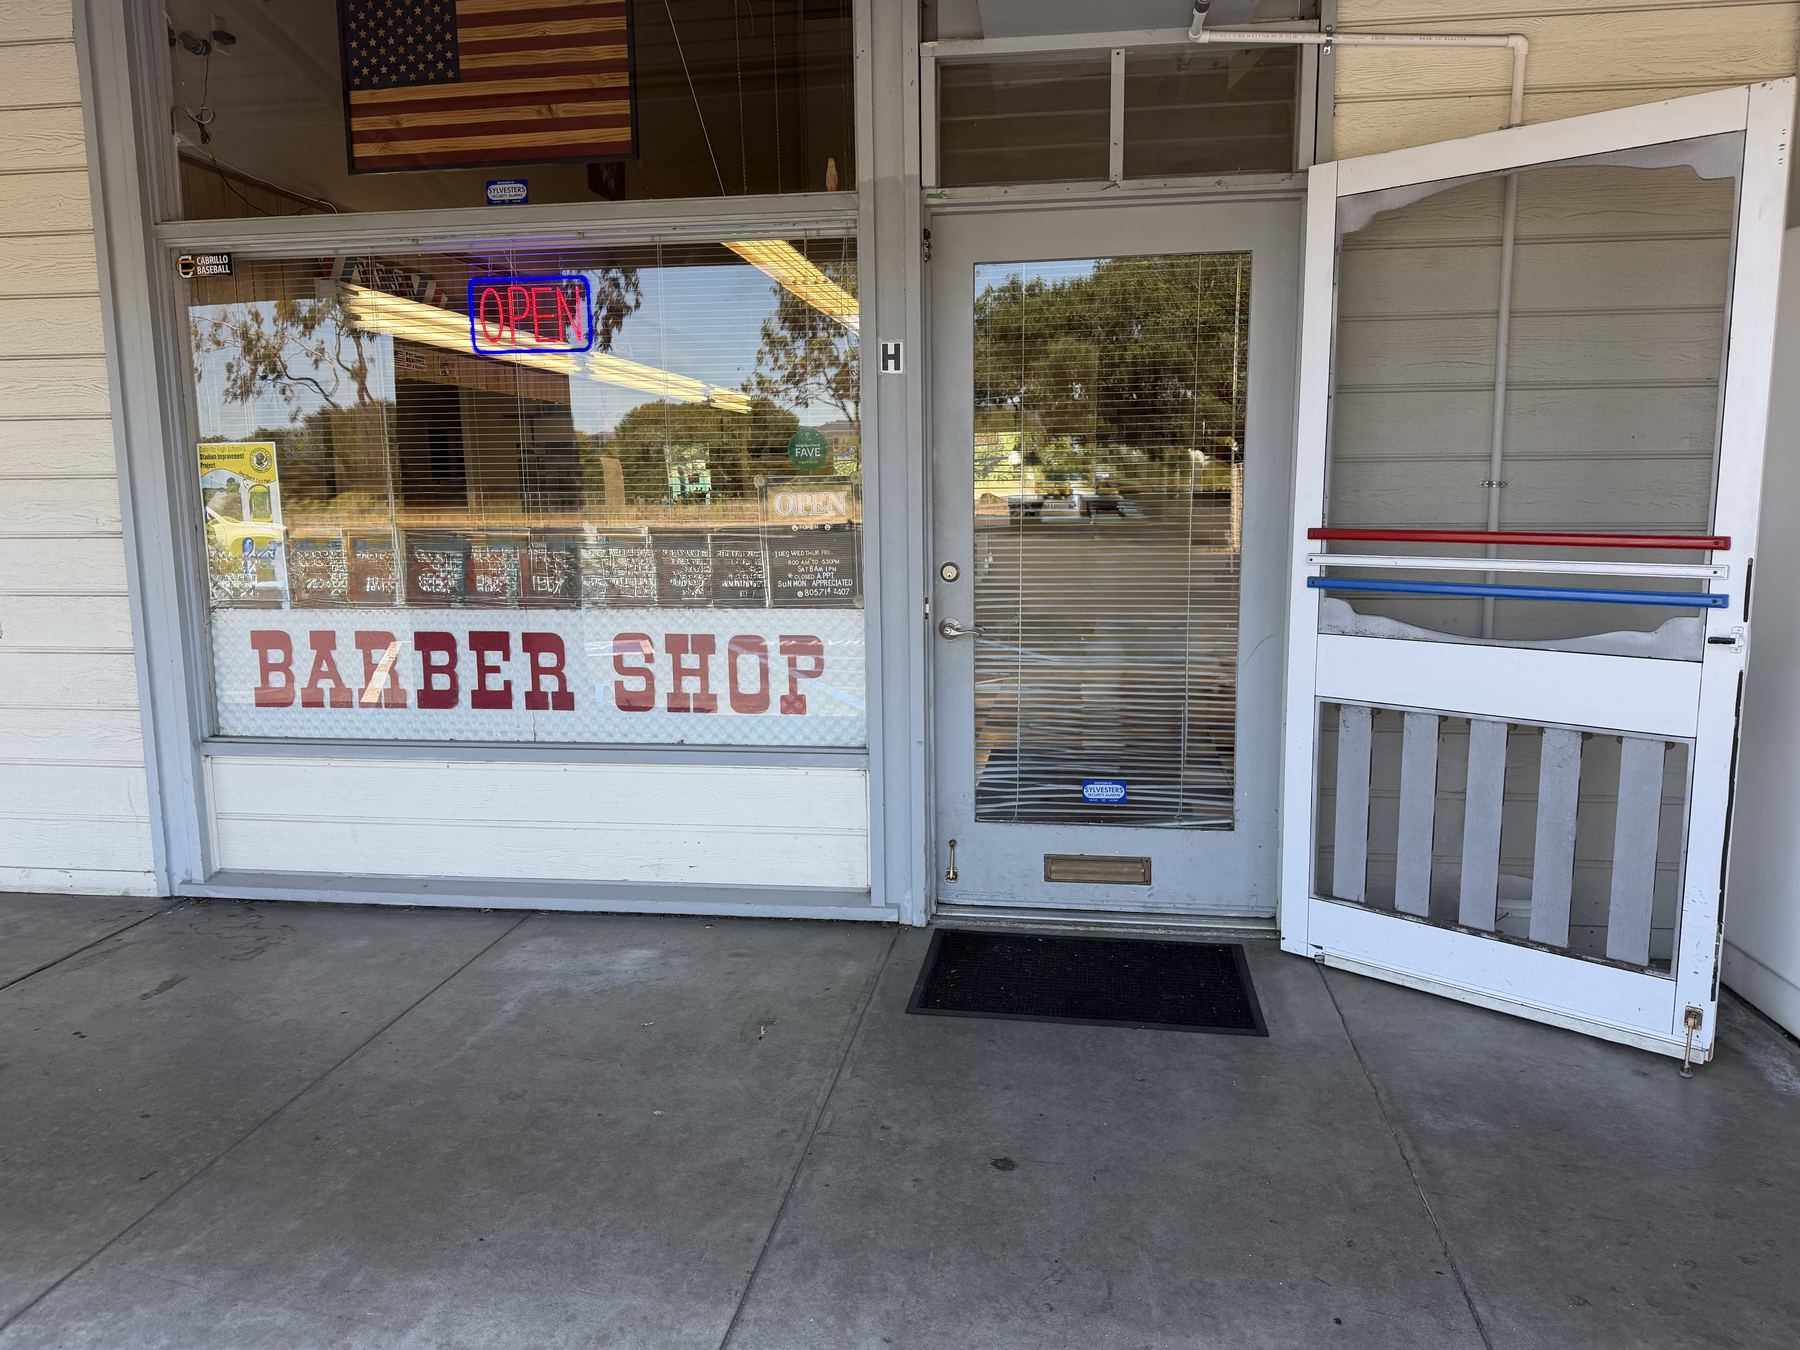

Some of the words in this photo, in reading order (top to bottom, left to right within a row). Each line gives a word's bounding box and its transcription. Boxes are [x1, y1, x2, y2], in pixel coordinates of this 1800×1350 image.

[488, 186, 526, 195] SYLVESTERS
[196, 255, 229, 266] CABRILLO
[196, 264, 231, 275] BASEBALL
[480, 286, 583, 344] OPEN
[882, 344, 900, 370] H
[795, 448, 821, 457] FAVE
[772, 491, 848, 517] OPEN
[812, 579, 853, 587] APPRECIATED
[250, 630, 575, 711] BARBER
[612, 632, 825, 716] SHOP
